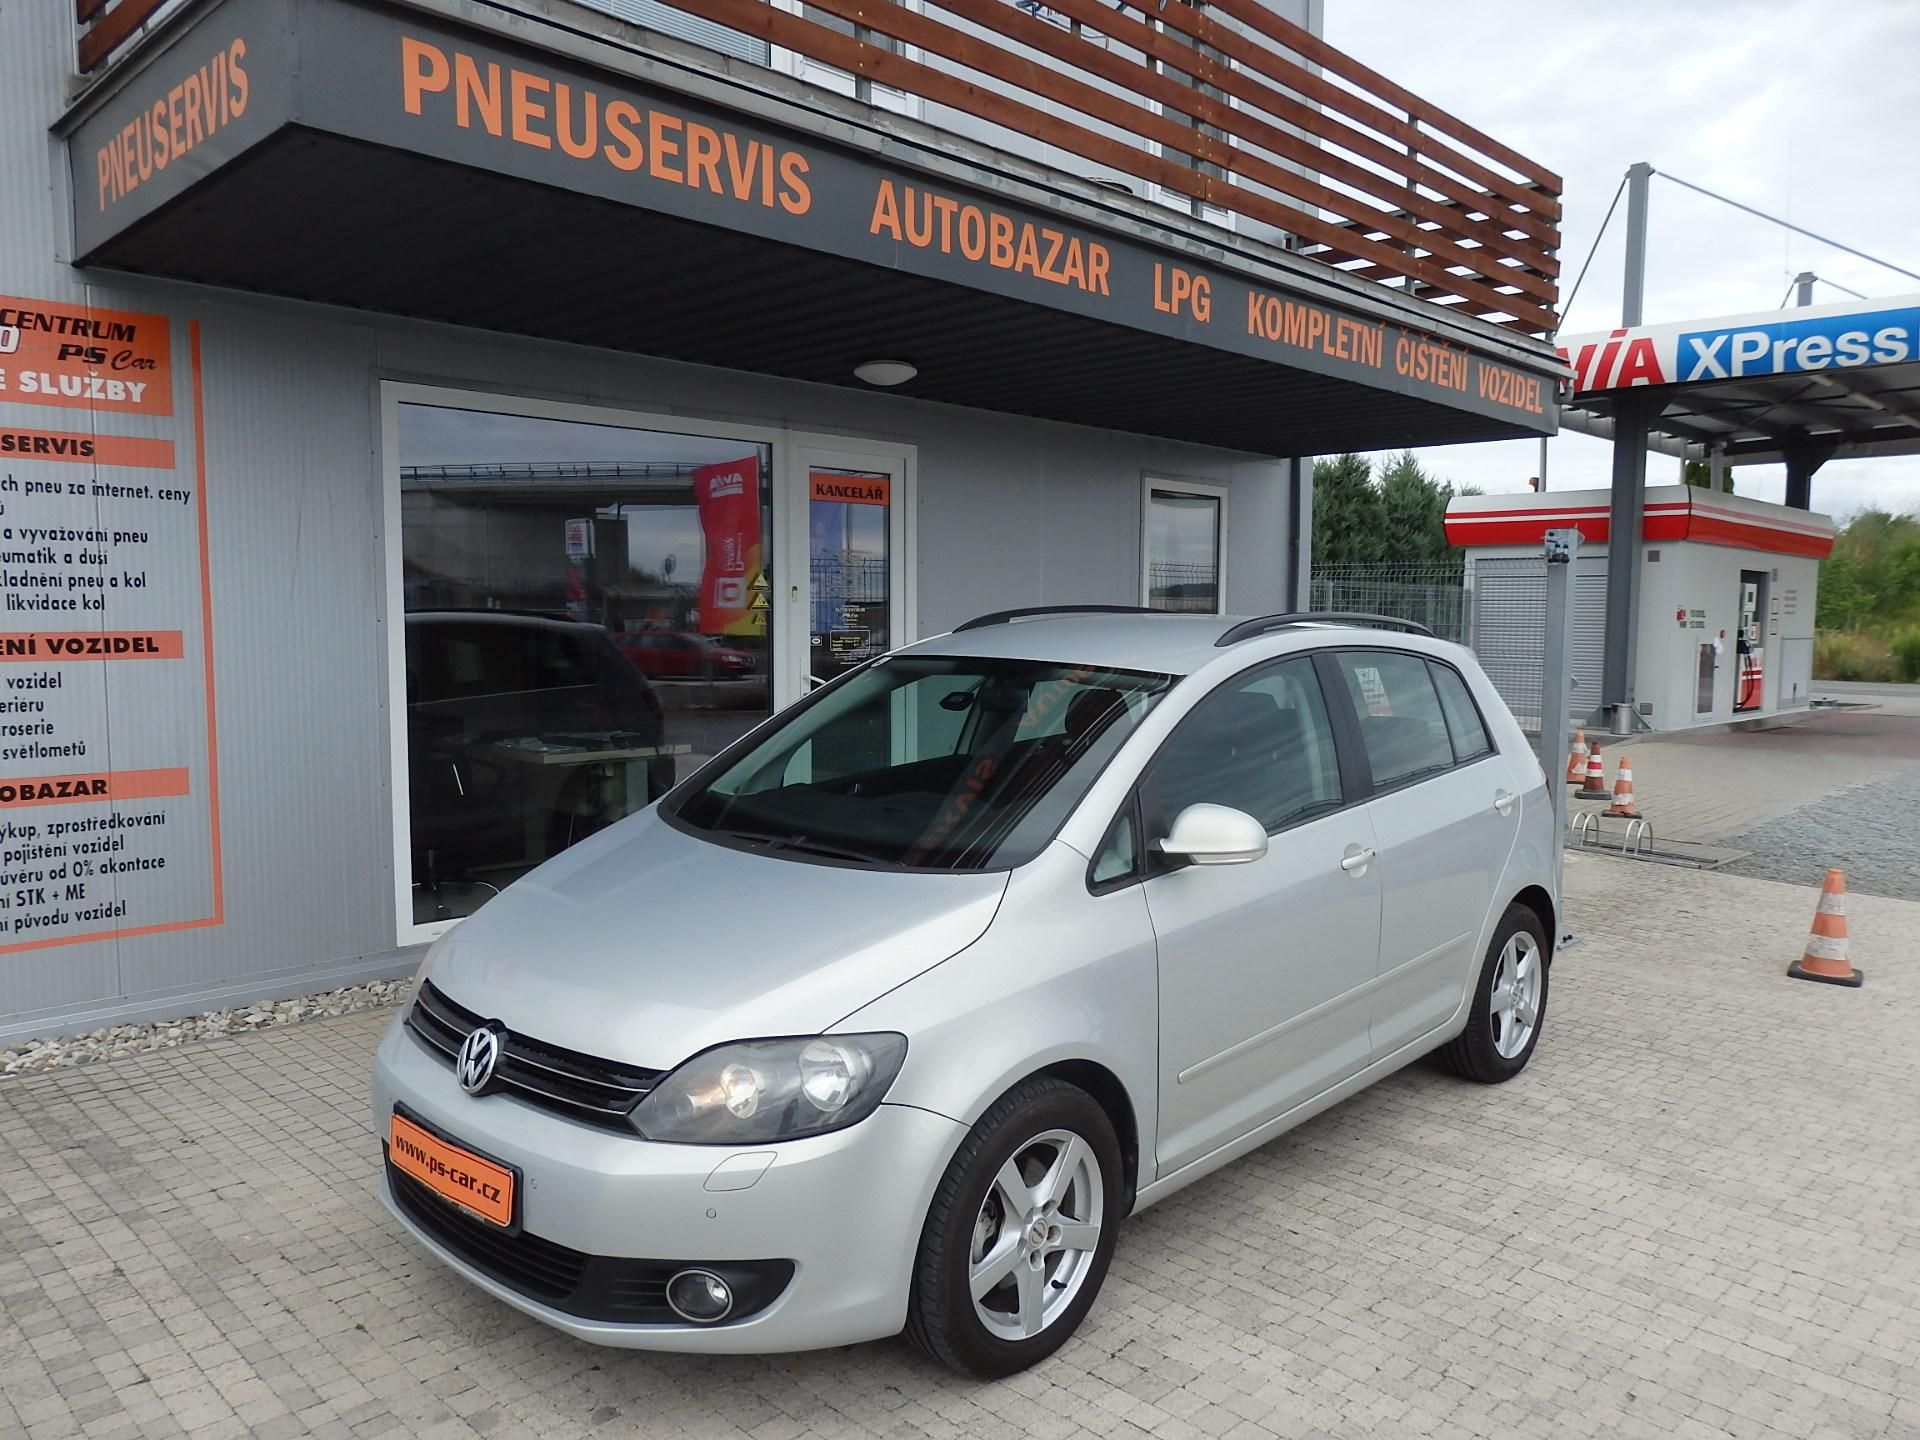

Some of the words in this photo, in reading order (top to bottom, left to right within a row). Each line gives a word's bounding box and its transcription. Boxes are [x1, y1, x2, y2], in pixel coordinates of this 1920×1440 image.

[97, 36, 249, 213] PNEUSERVIS
[400, 35, 813, 216] PNEUSERVIS
[868, 178, 1112, 297] AUTOBAZAR
[1153, 262, 1213, 325] LPG
[1248, 289, 1385, 368] KOMPLETNÍ
[1395, 326, 1469, 391] ČIŠTĚNÍ
[1477, 362, 1544, 415] VOZIDEL
[57, 343, 108, 365] PS
[111, 349, 158, 371] Car
[1688, 326, 1910, 381] XPress
[19, 371, 147, 403] SLUŽBY
[1, 434, 95, 457] SERVIS
[26, 480, 62, 496] pneu
[69, 483, 85, 495] za
[92, 480, 153, 499] internet.
[159, 489, 191, 505] ceny
[816, 483, 884, 500] KANCELÁŘ
[3, 528, 12, 539] a
[20, 527, 108, 544] vyvažování
[114, 531, 148, 546] pneu
[0, 548, 56, 564] umatik
[64, 553, 72, 564] a
[80, 548, 108, 565] duší
[69, 575, 104, 591] pneu
[110, 577, 118, 587] a
[125, 572, 146, 587] kol
[7, 594, 76, 610] likvidace
[83, 594, 105, 610] kol
[0, 634, 36, 655] NÍ
[46, 637, 159, 654] VOZIDEL
[7, 672, 62, 689] vozidel
[0, 719, 54, 736] roserie
[3, 741, 86, 760] světlometů
[47, 810, 166, 838] zprostředkování
[4, 844, 67, 866] pojištění
[72, 834, 124, 854] vozidel
[1, 869, 43, 886] úvěru
[50, 863, 67, 880] od
[73, 860, 94, 877] 0%
[100, 857, 166, 874] akontace
[16, 888, 46, 907] STK
[65, 883, 86, 901] ME
[15, 908, 69, 934] původu
[75, 900, 127, 921] vozidel
[396, 1135, 501, 1204] www.ps-car.cz
